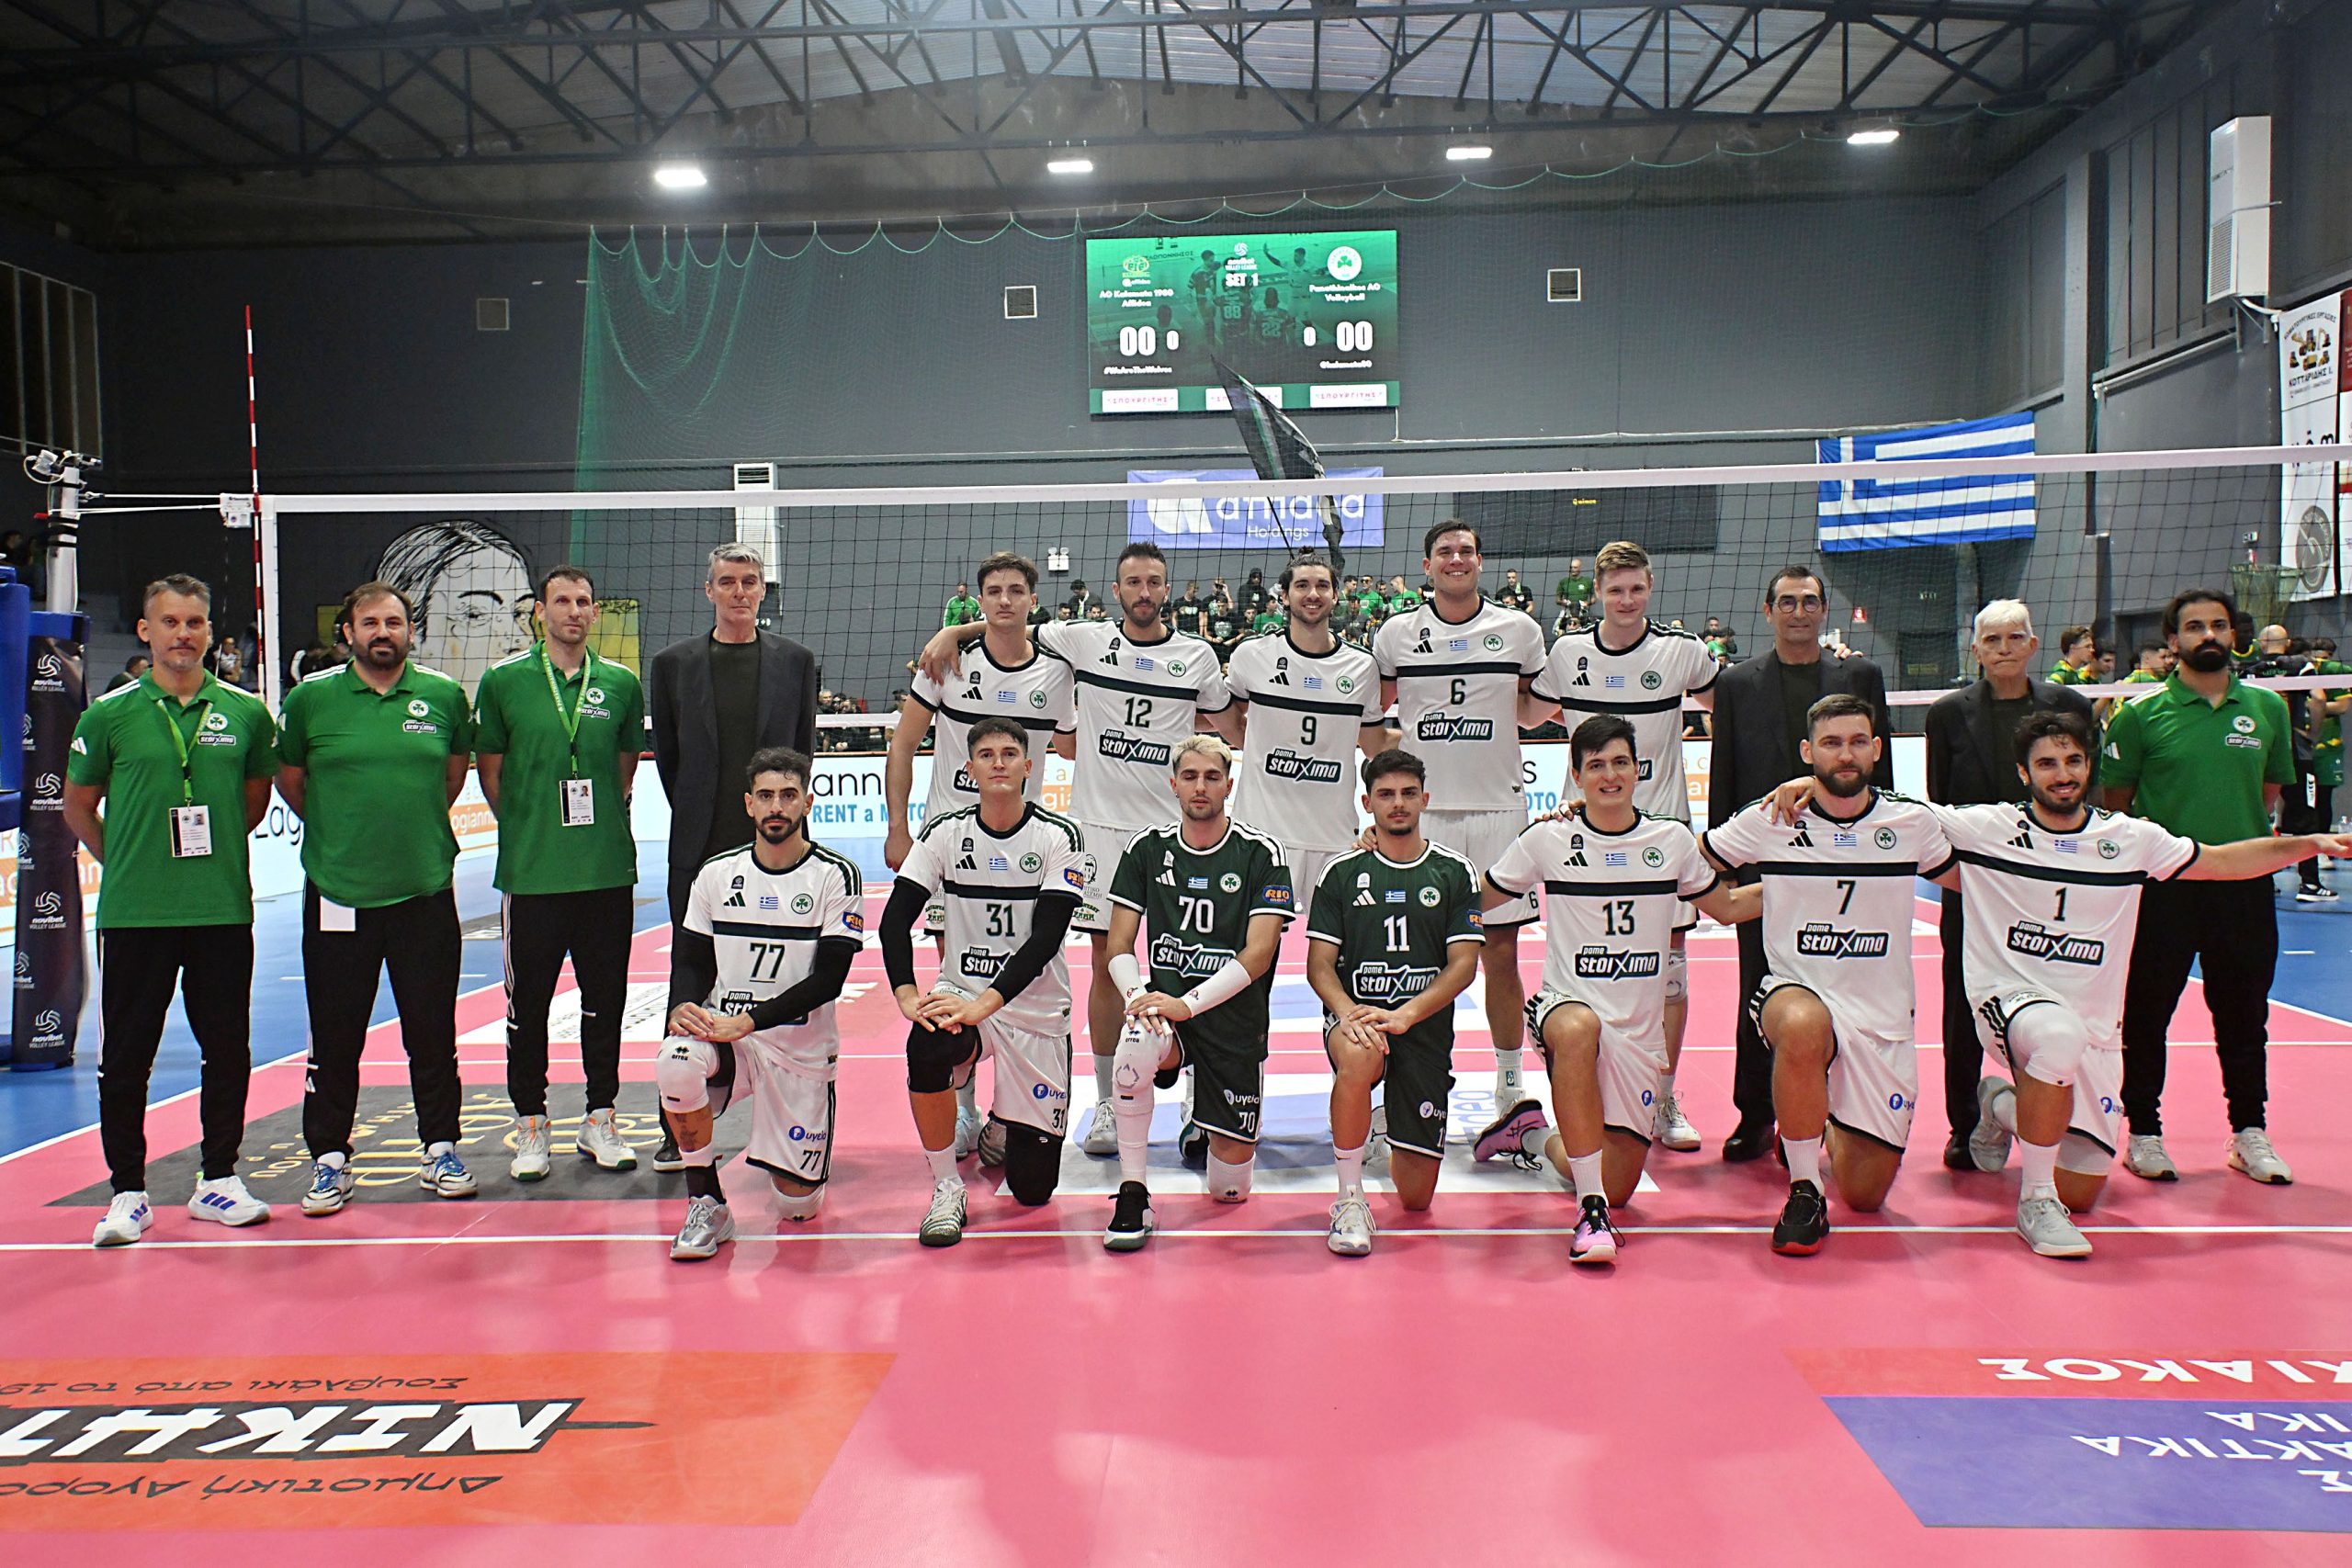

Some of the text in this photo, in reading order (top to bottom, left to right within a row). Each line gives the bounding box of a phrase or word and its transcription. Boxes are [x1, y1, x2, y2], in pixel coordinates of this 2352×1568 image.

[1226, 273, 1259, 287] SET 1
[1119, 325, 1156, 356] 00
[1166, 330, 1180, 350] 0
[1303, 326, 1317, 346] 0
[1336, 321, 1373, 352] 00
[1248, 525, 1309, 541] Holdings
[1451, 678, 1466, 705] 6
[1124, 696, 1152, 728] 12
[1301, 716, 1317, 746] 9
[813, 804, 857, 823] RENT
[865, 808, 874, 822] a
[1265, 888, 1290, 900] RIO
[1529, 891, 1539, 909] 6
[1837, 880, 1856, 915] 7
[2053, 886, 2067, 921] 1
[986, 903, 1015, 937] 31
[1178, 896, 1215, 933] 70
[1602, 900, 1635, 937] 13
[1384, 915, 1410, 953] 11
[750, 942, 786, 979] 77
[729, 992, 751, 1001] pame
[1052, 1108, 1066, 1130] 31
[1238, 1111, 1256, 1134] 70
[800, 1150, 821, 1172] 77
[0, 1376, 468, 1395] Σουβλάκι από το 19
[0, 1403, 572, 1457] ΝΙΚΗΤ
[2205, 1411, 2352, 1433] ΙΚΑ
[2071, 1435, 2352, 1461] ΑΚΤΙΚΑ
[200, 1473, 503, 1501] Δημοτική
